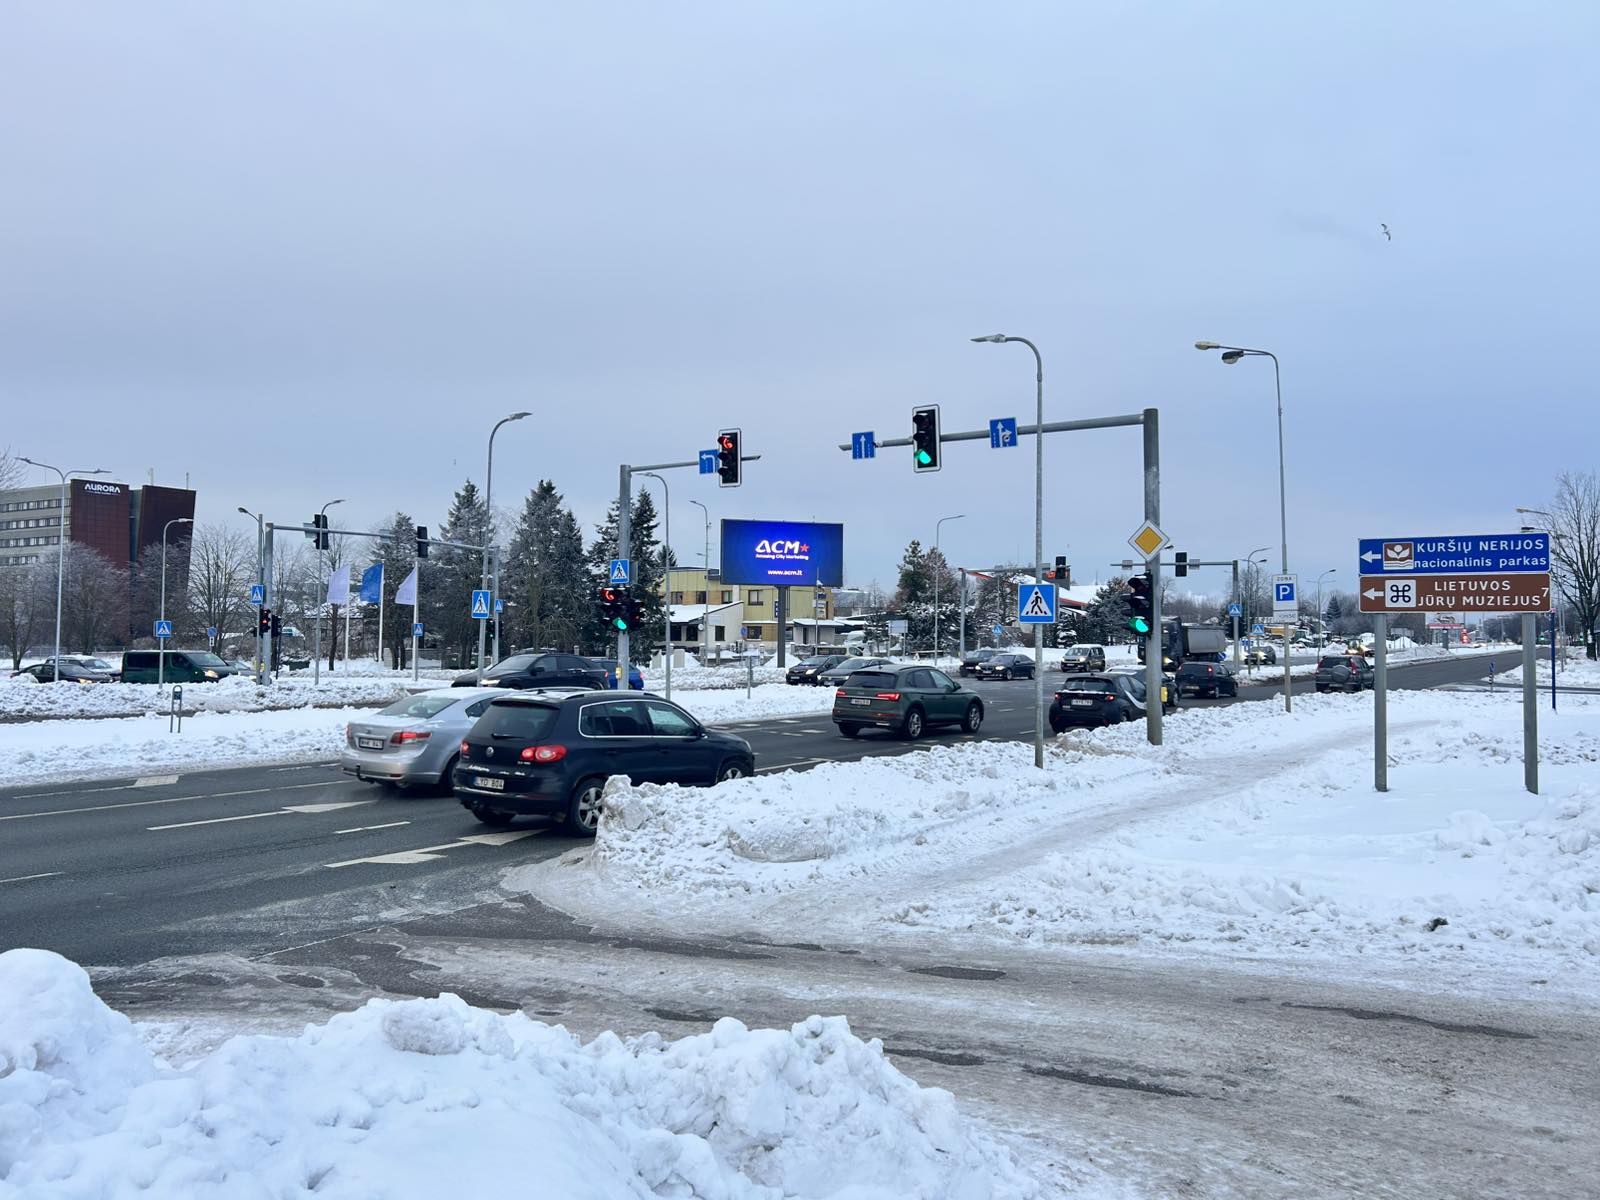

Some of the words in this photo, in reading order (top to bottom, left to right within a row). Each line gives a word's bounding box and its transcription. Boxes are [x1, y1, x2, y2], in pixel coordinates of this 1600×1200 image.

[84, 483, 120, 493] AURORA
[755, 540, 800, 554] ACM
[1417, 539, 1472, 553] KURŠIŲ
[1479, 539, 1544, 551] NERIJOS
[1414, 557, 1492, 568] nacionalinis
[1500, 555, 1547, 568] parkas
[1434, 580, 1511, 591] LIETUVOS
[1541, 587, 1549, 597] 7
[1279, 585, 1290, 600] P
[1418, 593, 1456, 608] JŪRŲ
[1462, 595, 1541, 606] MUZIEJUS
